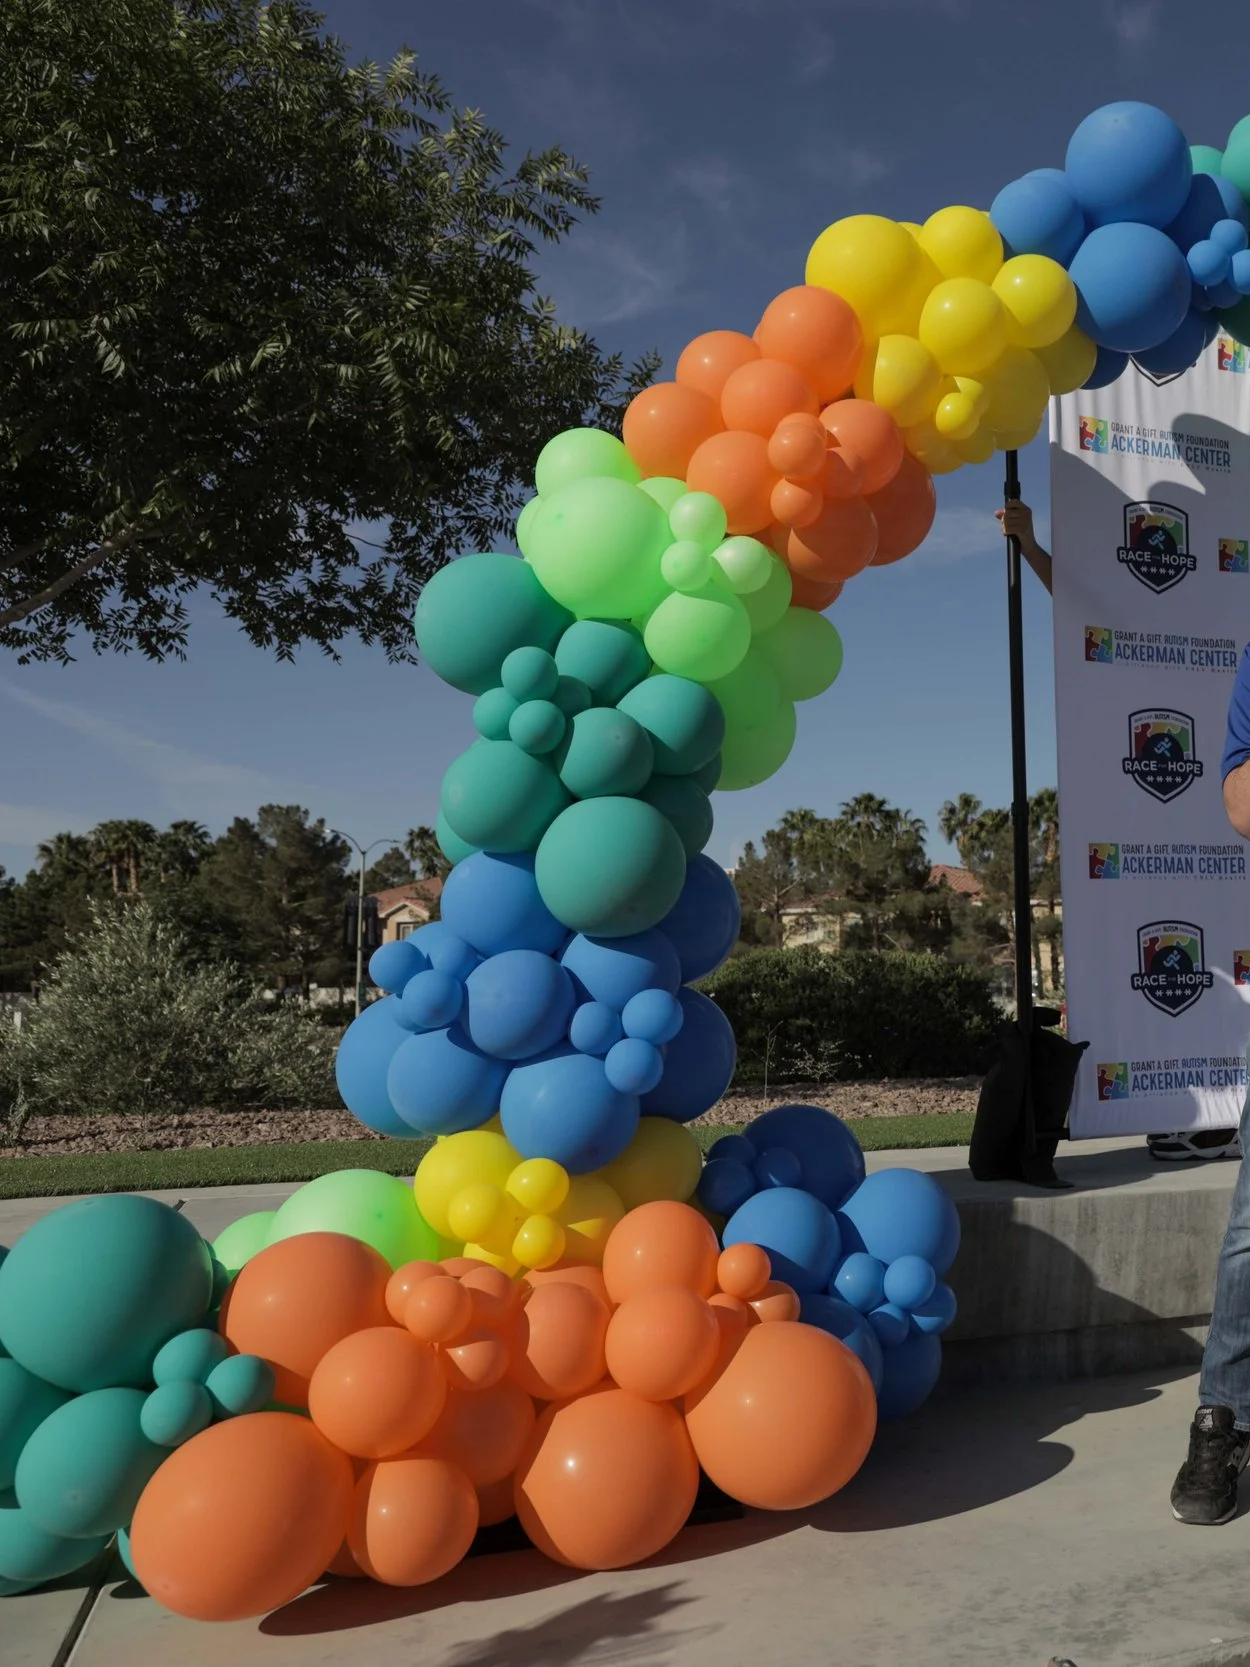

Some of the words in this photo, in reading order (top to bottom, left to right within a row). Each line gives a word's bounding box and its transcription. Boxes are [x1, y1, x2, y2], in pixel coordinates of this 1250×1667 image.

[1111, 422, 1133, 435] GRANT
[1136, 427, 1141, 436] A
[1159, 430, 1184, 443] AUTISM
[1186, 435, 1229, 449] FOUNDATION
[1111, 434, 1180, 460] ACKERMAN
[1185, 447, 1231, 467] CENTER
[1119, 550, 1151, 562] RACE
[1161, 554, 1194, 568] HOPE
[1115, 630, 1137, 643] GRANT
[1139, 633, 1144, 642] A
[1164, 634, 1189, 646] AUTISM
[1190, 637, 1235, 649] FOUNDATION
[1115, 643, 1186, 665] ACKERMAN
[1190, 649, 1237, 668] CENTER
[1124, 761, 1158, 772] RACE
[1168, 761, 1201, 774] HOPE
[1122, 844, 1144, 854] GRANT
[1146, 845, 1151, 854] A
[1172, 844, 1196, 854] AUTISM
[1199, 845, 1244, 855] FOUNDATION
[1122, 856, 1193, 874] ACKERMAN
[1199, 857, 1245, 874] CENTER
[1133, 974, 1167, 987] RACE
[1177, 974, 1210, 985] HOPE
[1131, 1061, 1155, 1072] GRANT
[1156, 1061, 1162, 1070] A
[1182, 1058, 1207, 1069] AUTISM
[1132, 1070, 1204, 1092] ACKERMAN
[1210, 1069, 1248, 1087] CENTE
